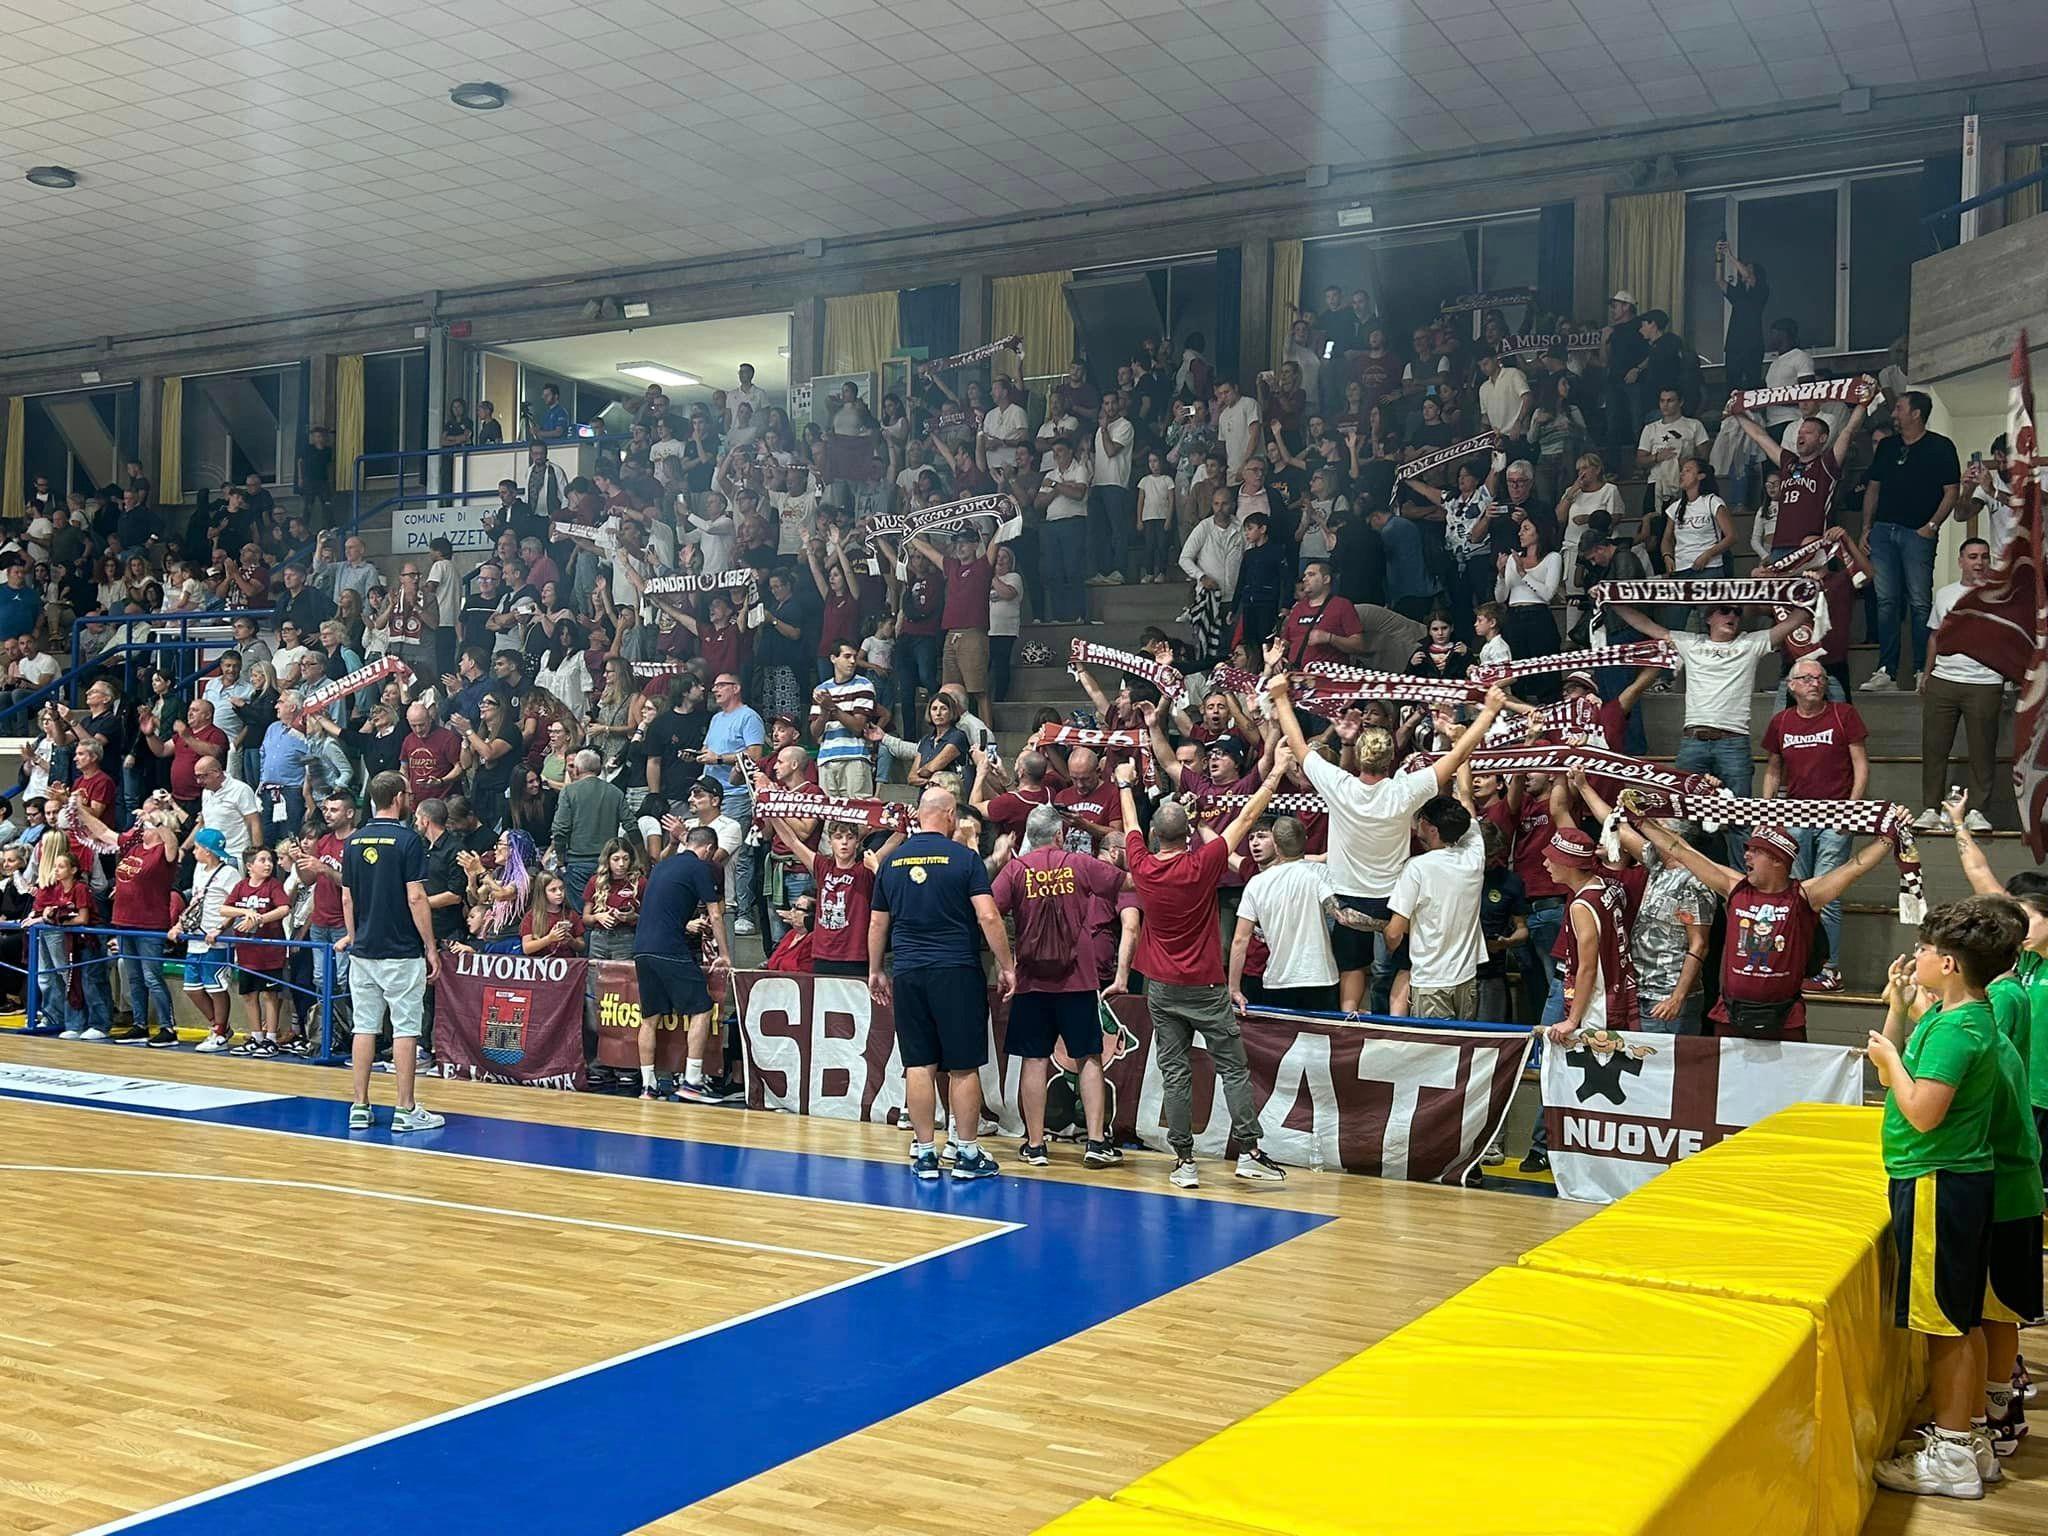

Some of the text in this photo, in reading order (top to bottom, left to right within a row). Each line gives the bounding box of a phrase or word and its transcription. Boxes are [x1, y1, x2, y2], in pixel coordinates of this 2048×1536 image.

[1517, 334, 1561, 348] MUSO
[1743, 378, 1853, 408] SBANDATI
[1783, 490, 1800, 504] 18
[404, 513, 445, 524] COMUNE
[458, 512, 466, 522] DI
[1618, 581, 1687, 600] GIVEN
[1691, 581, 1790, 601] SUNDAY
[303, 656, 389, 708] SBANDATI
[1359, 683, 1469, 700] LA STORIA
[769, 791, 824, 803] STORIA
[1025, 866, 1075, 884] Forza
[1025, 881, 1075, 899] Loris
[456, 952, 569, 981] LIVORNO
[1563, 1115, 1704, 1160] NUOVE
